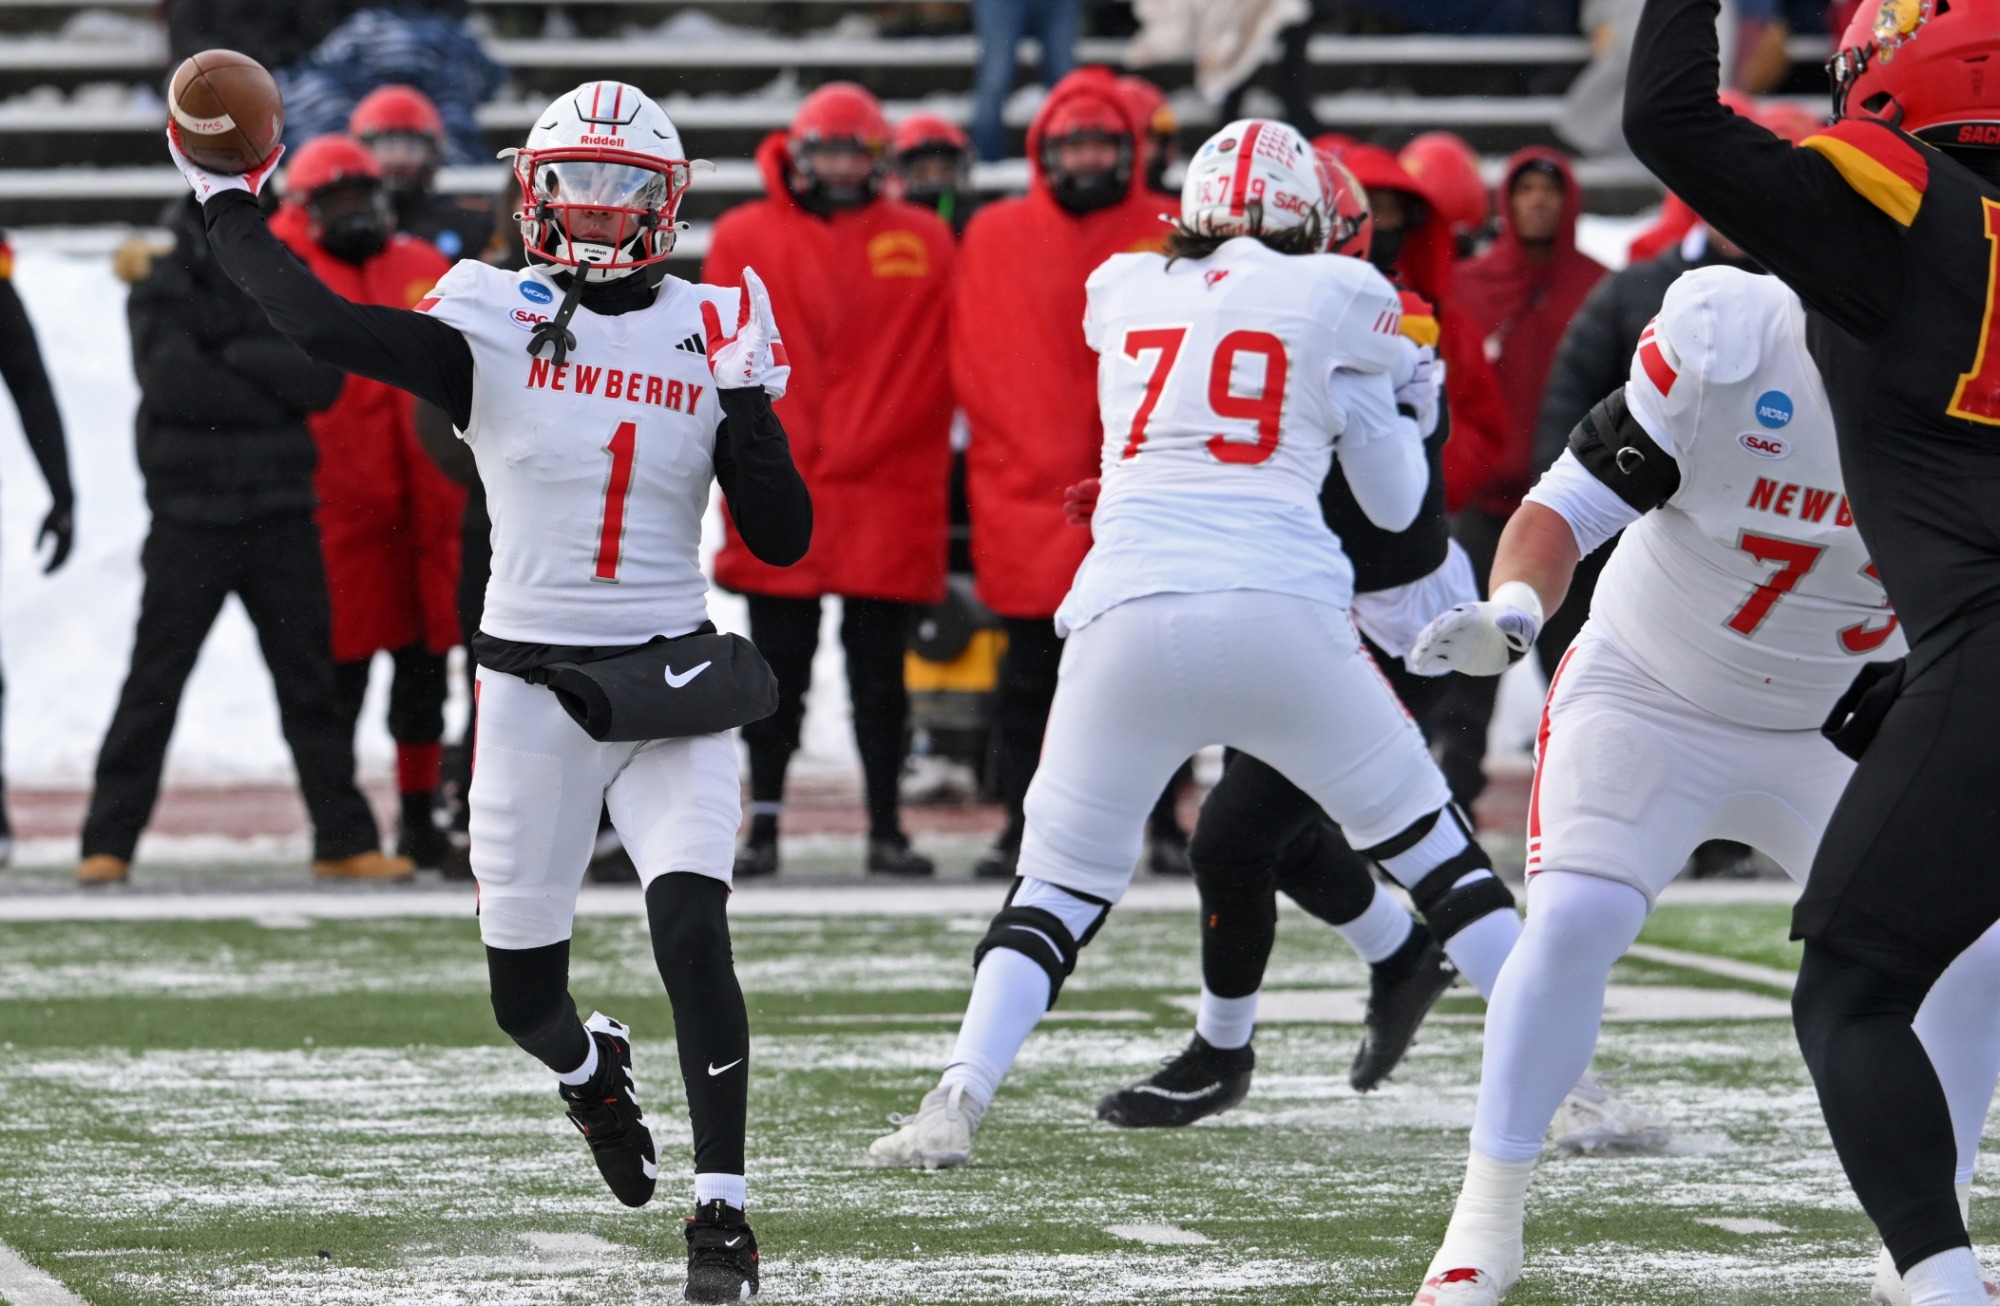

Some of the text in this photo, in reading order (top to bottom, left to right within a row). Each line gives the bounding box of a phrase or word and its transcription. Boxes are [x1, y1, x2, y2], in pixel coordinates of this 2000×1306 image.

[580, 135, 625, 148] Riddell
[1957, 125, 2000, 144] SAC
[1272, 191, 1311, 218] SAC
[522, 287, 552, 302] NCAA
[526, 356, 704, 416] NEWBERRY
[1118, 323, 1291, 468] 79
[1759, 405, 1790, 423] NCAA
[1745, 436, 1782, 455] SAC
[591, 417, 641, 584] 1
